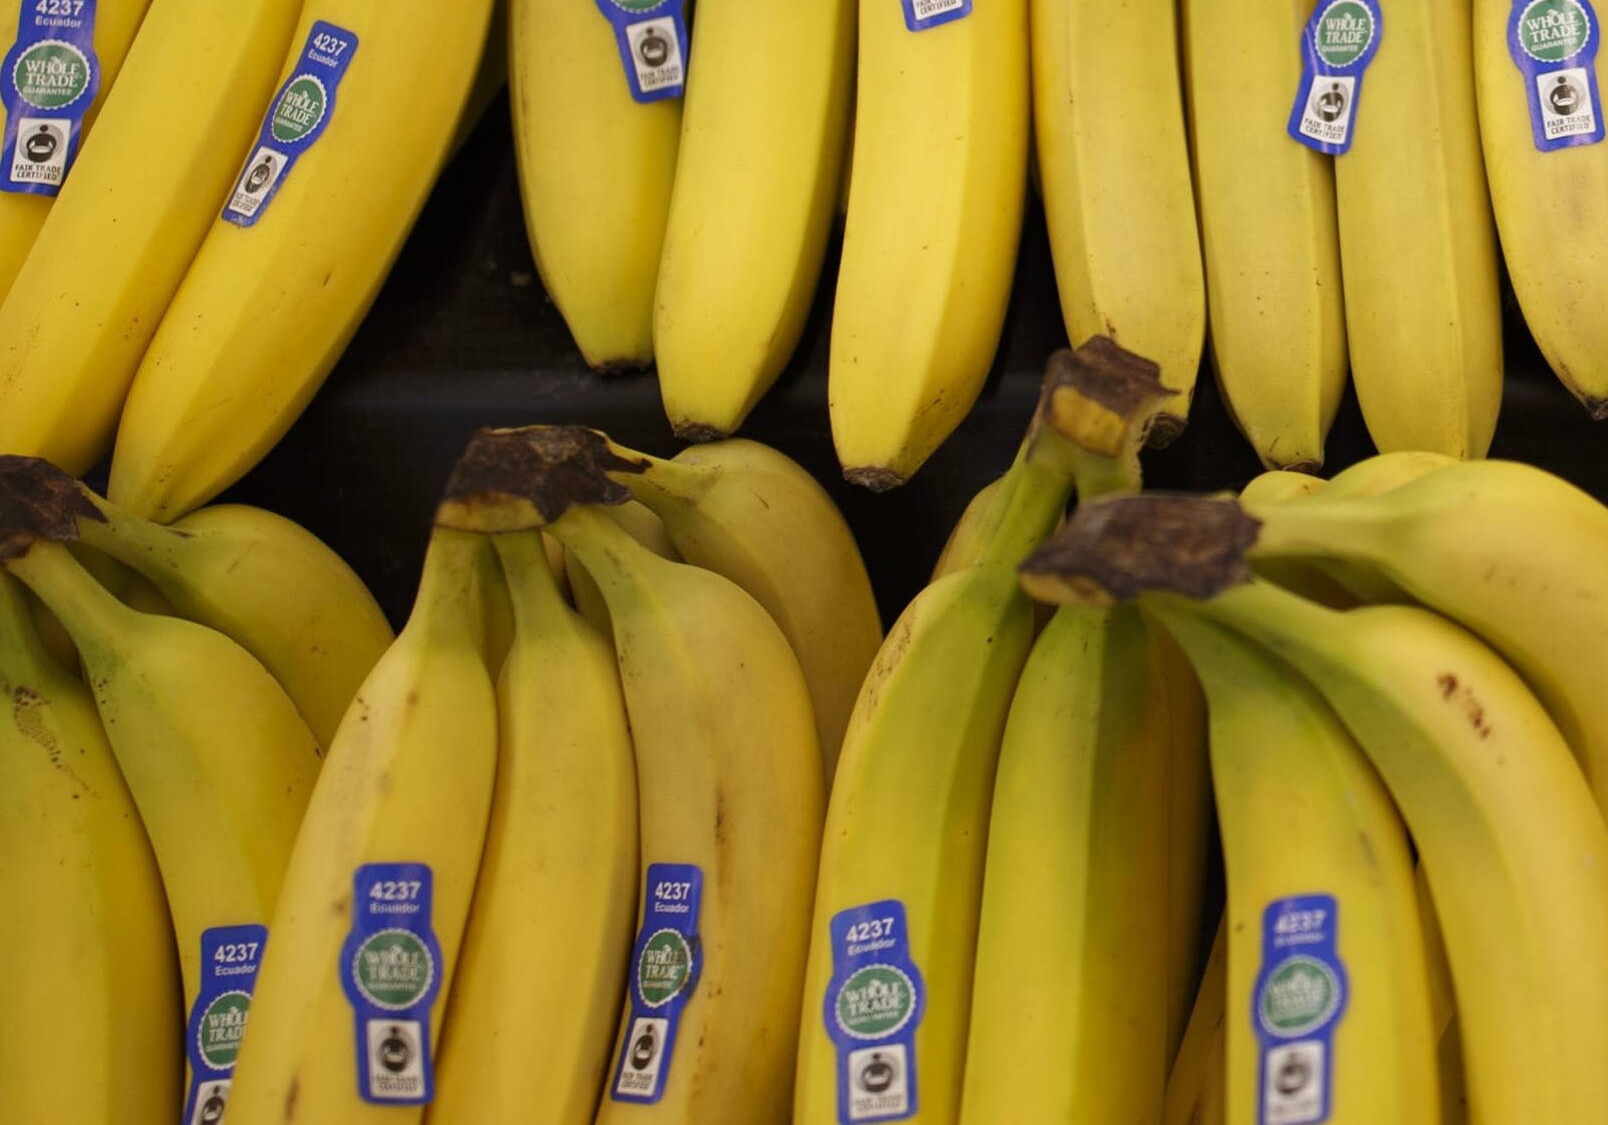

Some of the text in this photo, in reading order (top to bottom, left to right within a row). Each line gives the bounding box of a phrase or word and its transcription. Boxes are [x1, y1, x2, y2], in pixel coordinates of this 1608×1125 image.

[35, 16, 82, 29] Ecuador
[1326, 16, 1366, 31] WHOLE
[1526, 11, 1577, 31] WHOLE
[1325, 30, 1363, 44] TRADE
[1530, 24, 1581, 43] TRADE
[313, 33, 348, 56] 4237
[26, 59, 80, 76] WHOLE
[307, 49, 339, 68] Ecuador
[25, 73, 79, 88] TRADE
[287, 91, 320, 113] WHOLE
[280, 104, 314, 125] TRADE
[369, 881, 421, 900] 4237
[655, 882, 691, 900] 4237
[654, 902, 689, 914] Ecuador
[846, 918, 894, 942] 4237
[214, 942, 258, 962] 4237
[215, 964, 257, 976] Ecuador
[209, 1011, 248, 1028] WHOL
